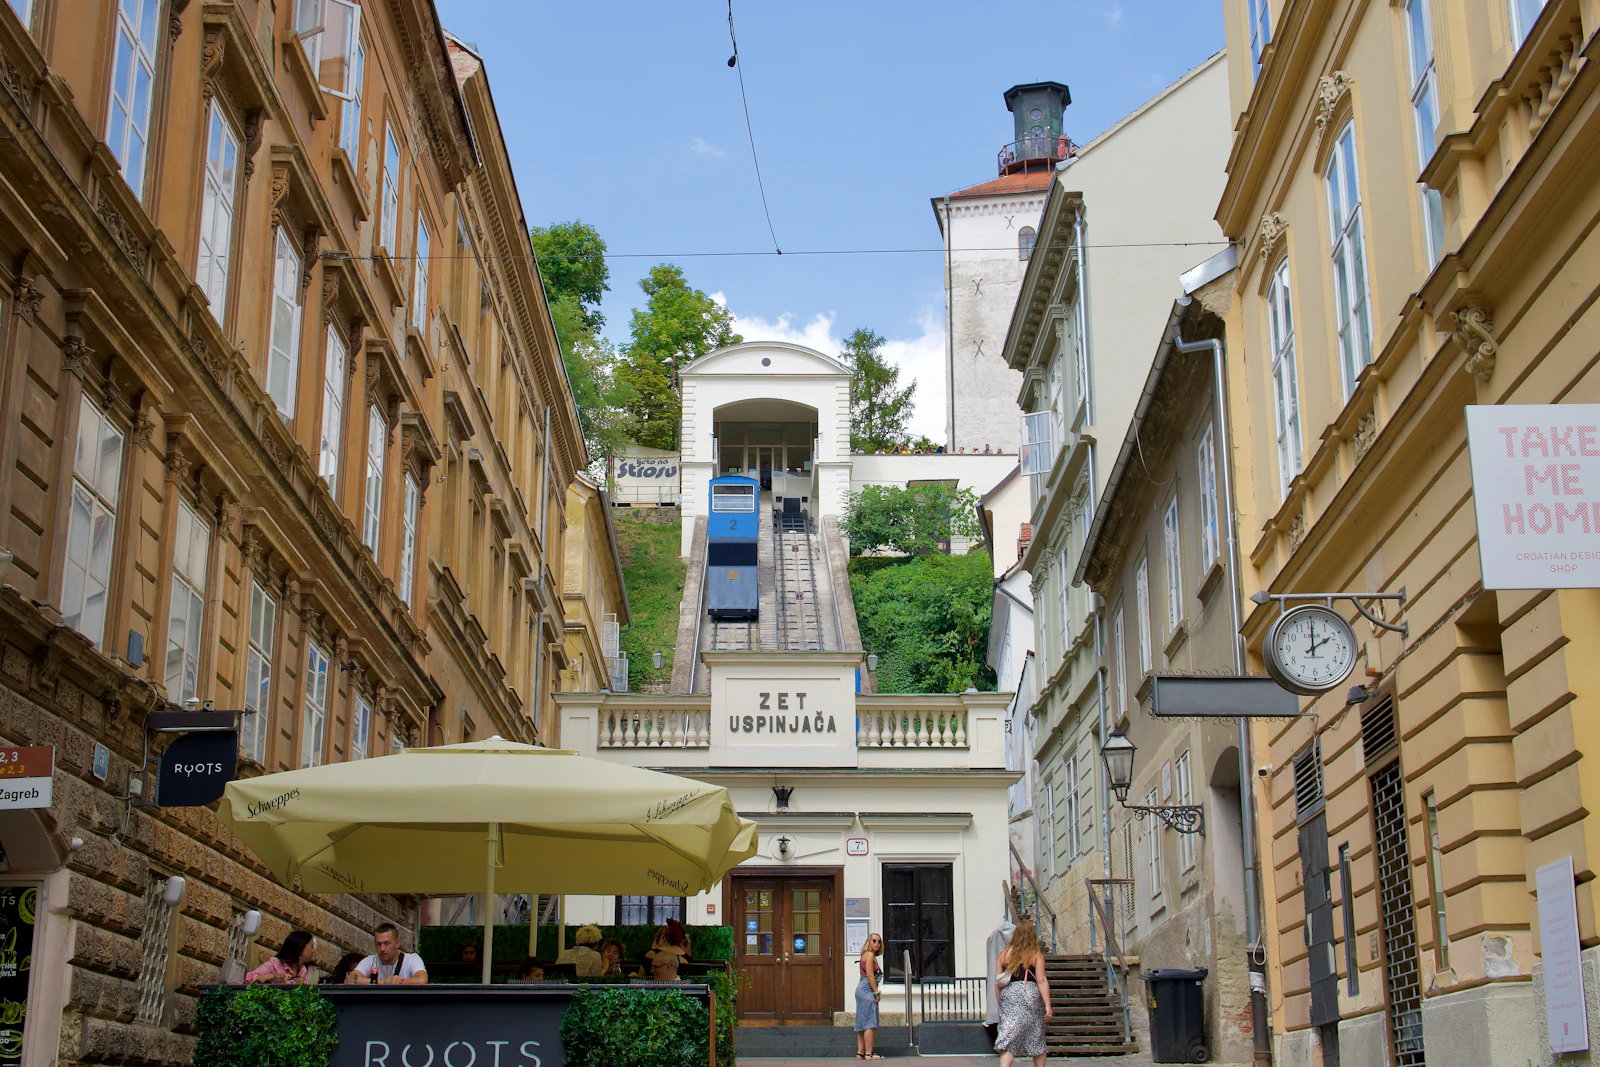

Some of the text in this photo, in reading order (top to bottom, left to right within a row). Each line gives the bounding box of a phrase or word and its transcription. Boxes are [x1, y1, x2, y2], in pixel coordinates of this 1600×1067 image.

[1498, 426, 1600, 457] TAKE
[617, 458, 677, 478] Štrosu
[1524, 464, 1584, 495] ME
[729, 519, 738, 530] 2
[1516, 552, 1567, 561] CROATIAN
[1550, 564, 1579, 573] SHOP
[1295, 624, 1304, 633] 11
[1287, 633, 1297, 642] 10
[1331, 632, 1336, 641] 2
[1285, 645, 1291, 653] 9
[1335, 643, 1340, 653] 3
[1291, 656, 1296, 665] 8
[1332, 655, 1337, 664] 4
[1300, 665, 1306, 674] 7
[1312, 667, 1318, 676] 6
[1325, 664, 1331, 673] 5
[759, 692, 807, 710] ZET
[729, 710, 837, 733] USPINJAČA
[11, 751, 18, 762] 3
[7, 765, 15, 775] 2,
[18, 764, 25, 774] 3
[247, 787, 301, 819] Schweppes
